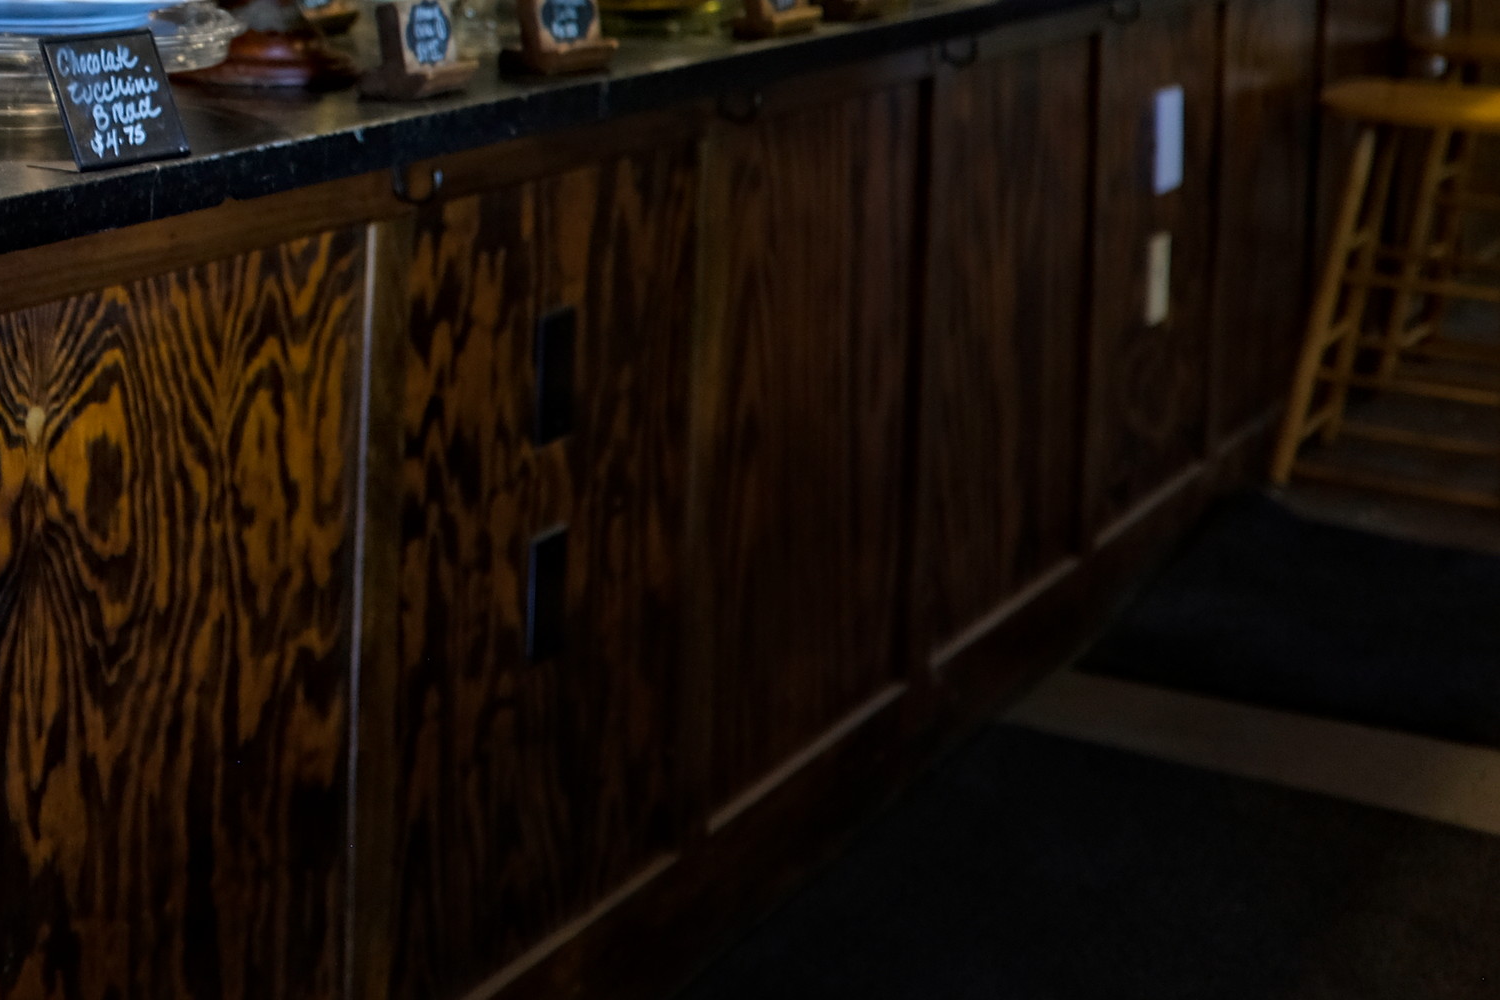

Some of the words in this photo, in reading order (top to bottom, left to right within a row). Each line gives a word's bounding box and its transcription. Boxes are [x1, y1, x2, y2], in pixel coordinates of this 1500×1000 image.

[56, 44, 139, 78] Chocolate
[66, 65, 160, 105] Zucchini
[90, 122, 147, 159] $4.75
